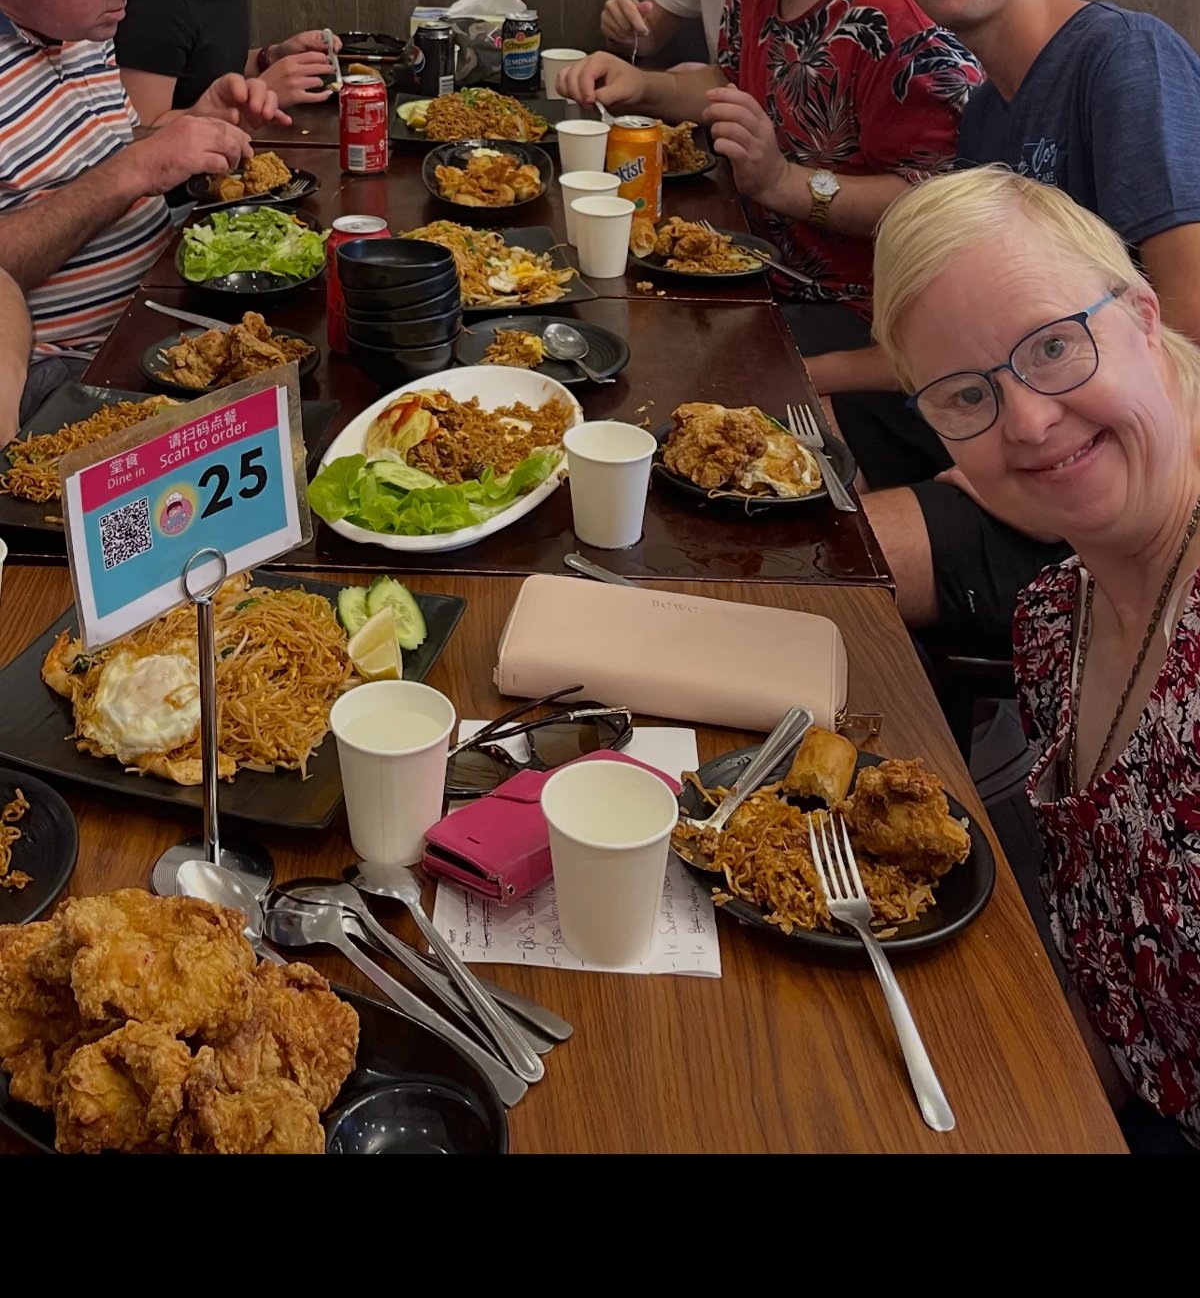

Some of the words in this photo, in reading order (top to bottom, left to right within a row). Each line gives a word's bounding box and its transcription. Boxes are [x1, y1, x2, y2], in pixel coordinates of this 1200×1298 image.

[159, 448, 190, 469] Scan
[194, 438, 208, 451] to
[211, 420, 248, 445] order
[168, 408, 237, 450] 请扫码点餐
[107, 471, 132, 490] Dine
[135, 466, 146, 478] in
[109, 453, 139, 476] 堂食
[198, 446, 268, 520] 25
